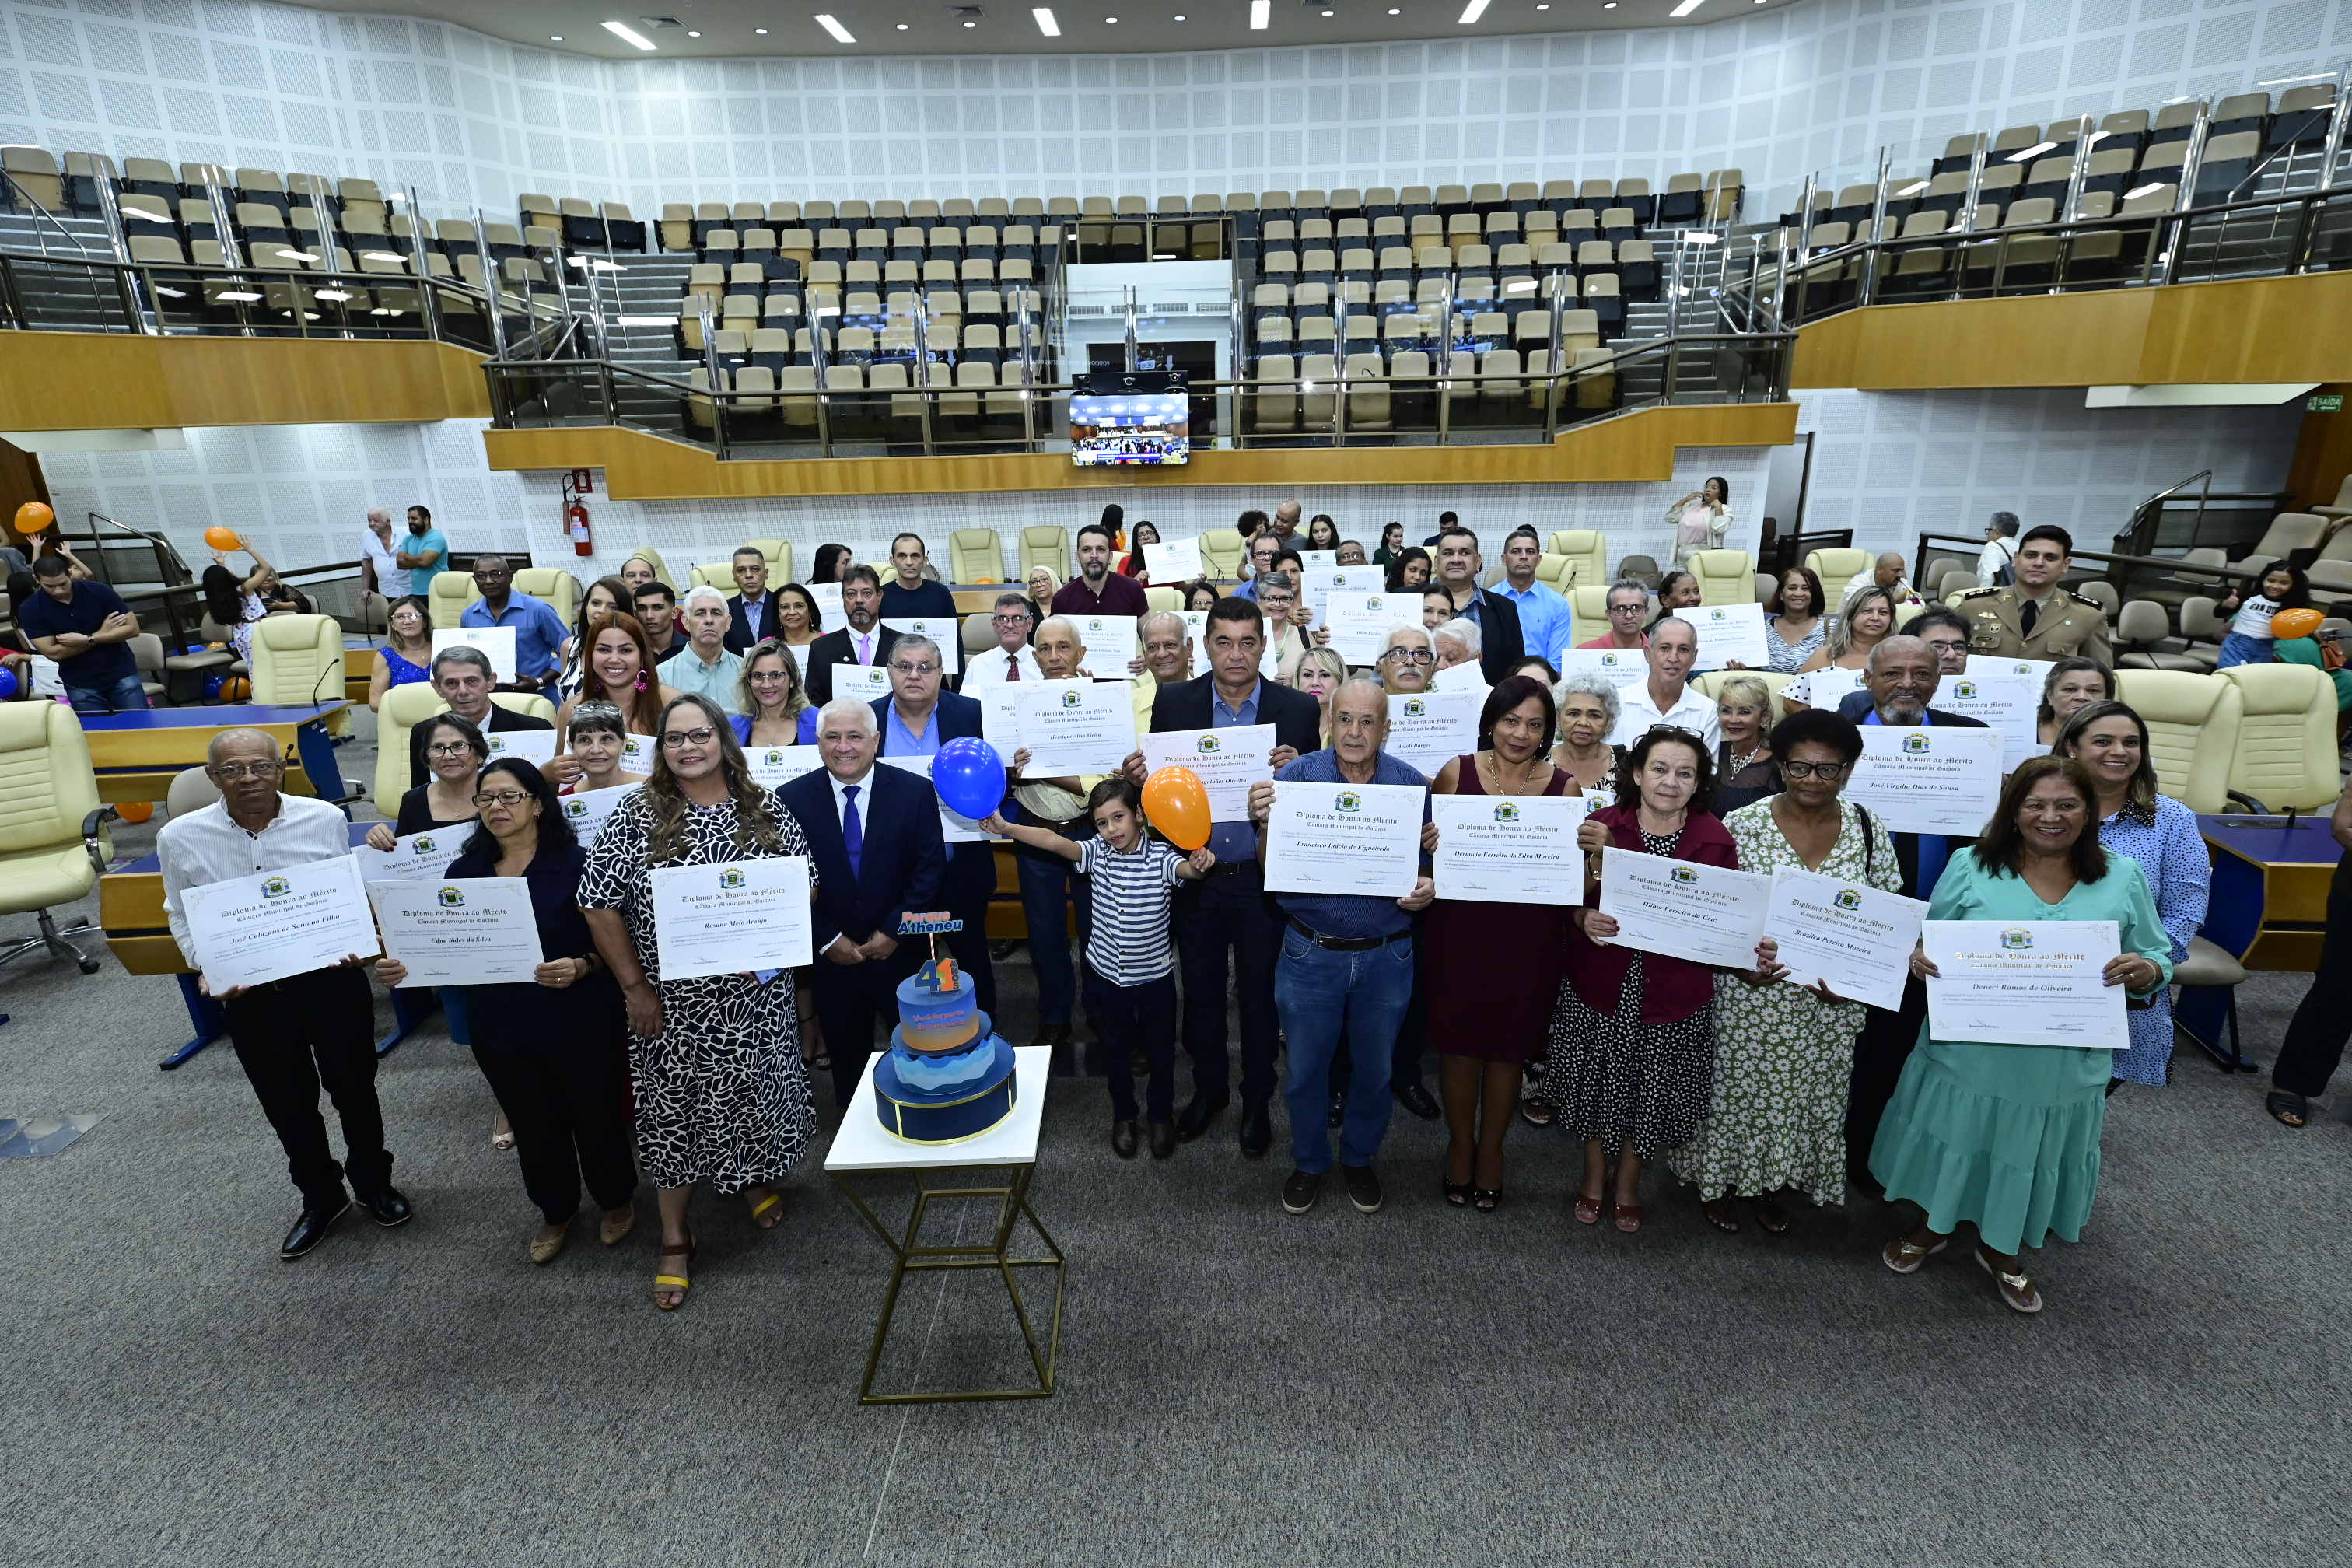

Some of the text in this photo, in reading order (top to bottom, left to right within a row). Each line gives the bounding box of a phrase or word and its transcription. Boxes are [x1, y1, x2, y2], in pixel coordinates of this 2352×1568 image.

[1296, 811, 1325, 821] Diploma
[1339, 814, 1360, 822] Honra
[1373, 816, 1397, 824] Mérito
[1630, 874, 1661, 886] Diploma
[1675, 884, 1699, 894] Honra
[1712, 893, 1739, 902] Mérito
[219, 905, 256, 919] Diploma
[271, 896, 296, 907] Honra
[310, 888, 337, 899] Mérito
[902, 911, 950, 922] Parque
[1792, 898, 1822, 912] Diploma
[1834, 909, 1857, 921] Honra
[1867, 920, 1894, 931] Mérito
[898, 920, 962, 933] Atheneu
[1955, 951, 1993, 960] Diploma
[2053, 952, 2085, 961] Mérito
[915, 958, 960, 992] 41
